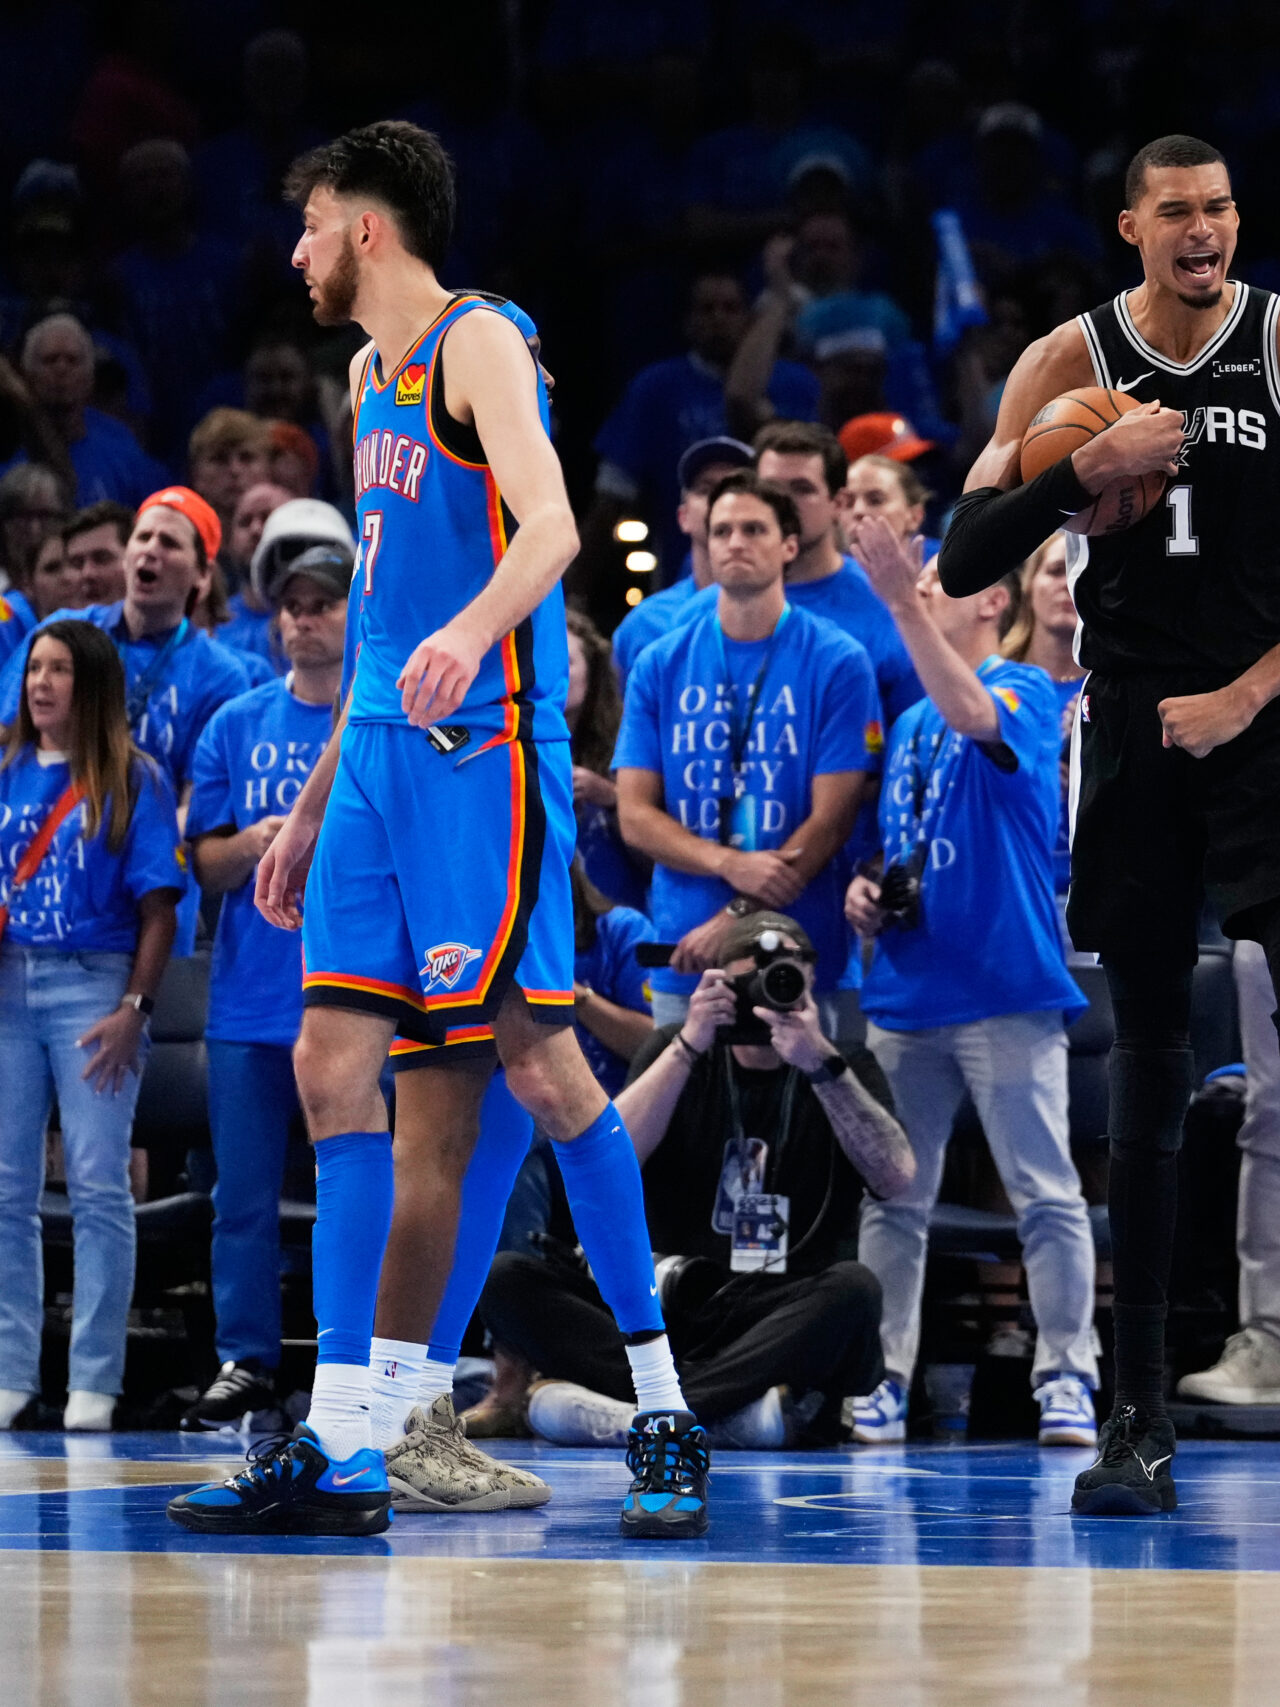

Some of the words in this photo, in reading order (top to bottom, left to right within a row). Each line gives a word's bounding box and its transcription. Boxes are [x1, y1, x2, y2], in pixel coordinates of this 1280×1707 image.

[1218, 363, 1255, 373] LEDGER
[354, 429, 429, 504] HUNDER
[363, 510, 383, 596] 7
[1166, 485, 1200, 556] 1
[431, 951, 459, 979] OKC
